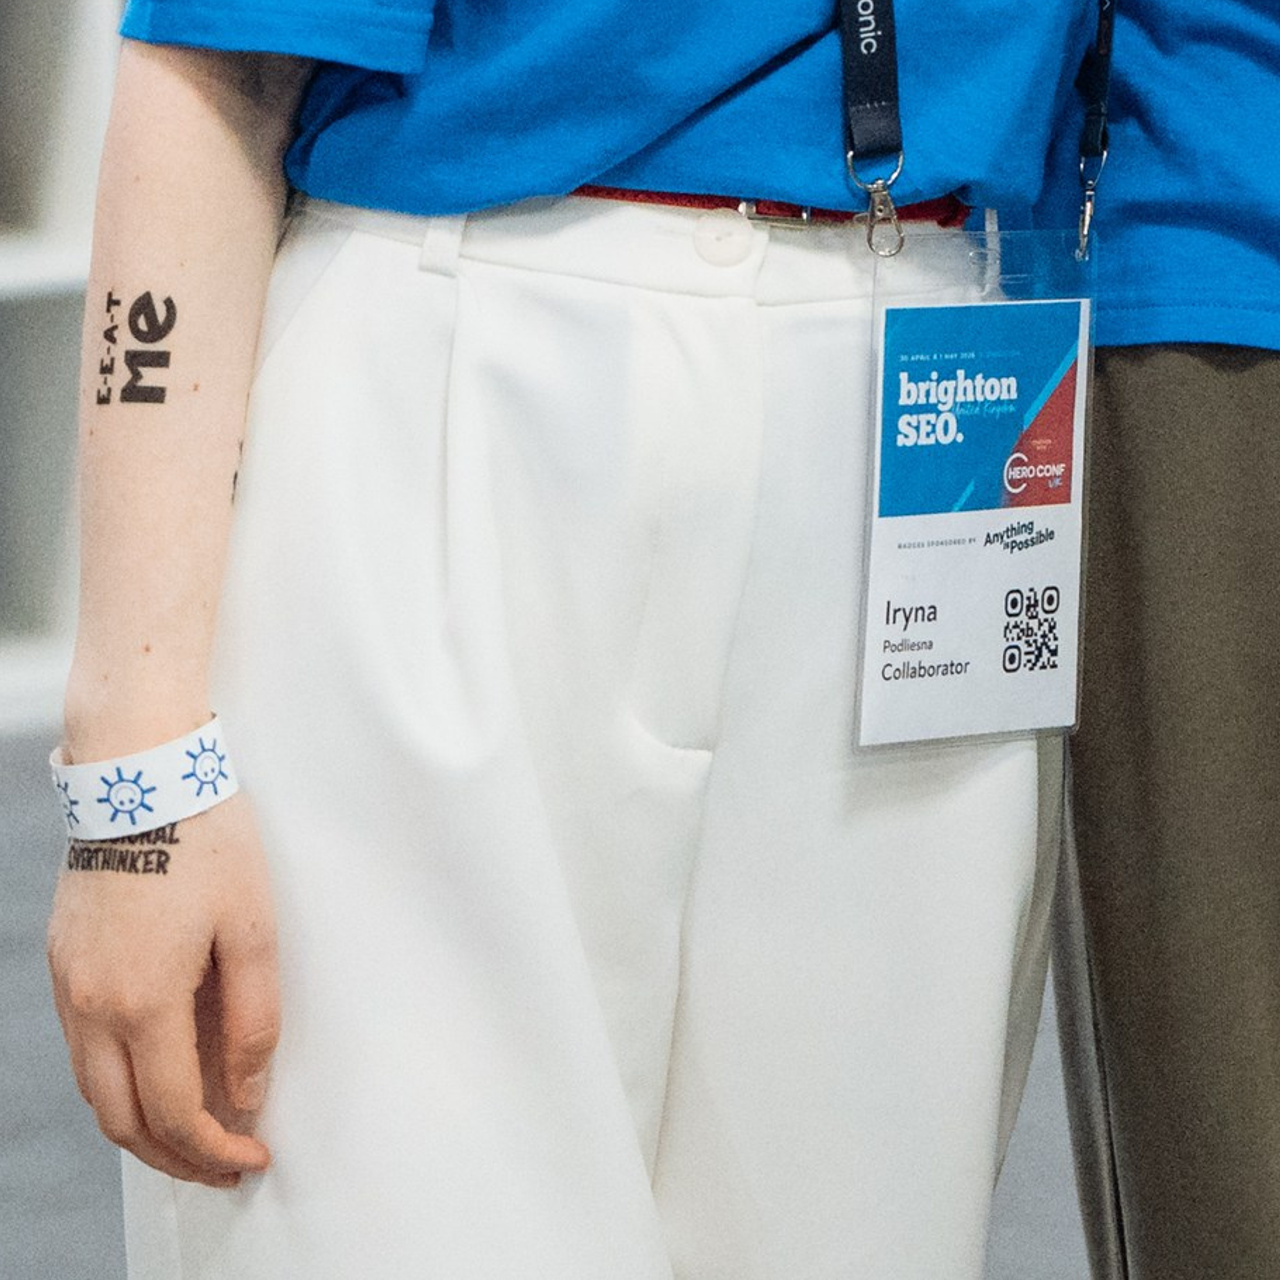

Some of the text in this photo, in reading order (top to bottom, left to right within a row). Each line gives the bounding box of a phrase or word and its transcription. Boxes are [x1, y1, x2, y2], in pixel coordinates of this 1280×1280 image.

[96, 291, 121, 405] E-E-A-T
[120, 291, 177, 404] Me
[898, 369, 1018, 411] brighton
[896, 412, 964, 447] SEO.
[1008, 463, 1066, 480] HERO CONF
[983, 521, 1034, 547] Anything
[1009, 528, 1055, 554] Possible
[885, 601, 938, 631] Iryna
[882, 638, 934, 654] Podliesna
[881, 660, 970, 681] Collaborator
